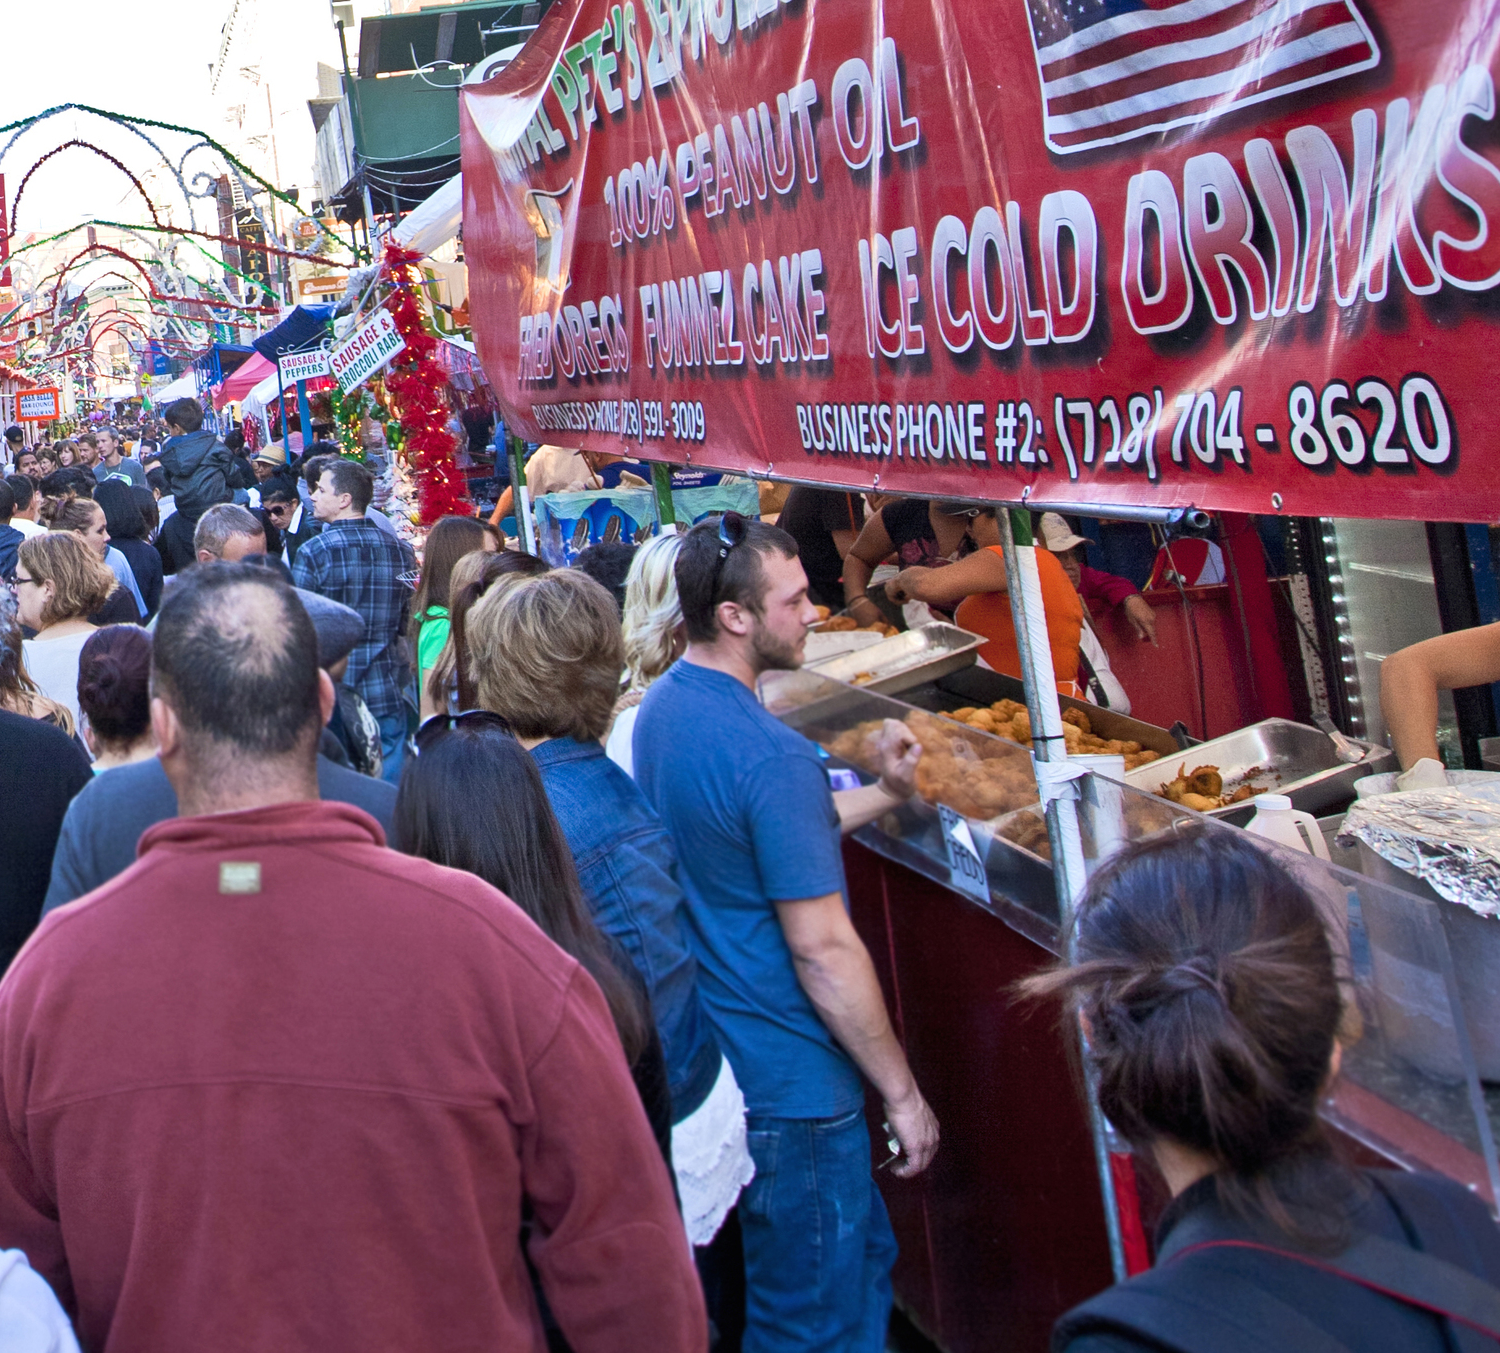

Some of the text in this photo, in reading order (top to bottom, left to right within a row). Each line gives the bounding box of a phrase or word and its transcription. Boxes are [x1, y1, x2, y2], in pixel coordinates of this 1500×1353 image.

[605, 149, 675, 249] 100%
[674, 79, 820, 219] PEANUT
[517, 312, 554, 381] FRIED
[553, 293, 631, 379] OREOS
[742, 248, 829, 364] CAKE
[858, 225, 924, 359] ICE
[931, 190, 1098, 353] COLD
[1121, 63, 1500, 335] DRINKS
[281, 353, 326, 369] SAUSAGE &
[285, 363, 324, 379] PEPPERS
[332, 317, 390, 374] SAUSAGE &
[338, 329, 402, 391] BROCCOLI RABE
[531, 401, 587, 431] BUSINESS
[618, 397, 643, 444] (78)
[643, 401, 665, 437] 591
[671, 401, 706, 441] 3009
[797, 402, 891, 458] BUSINESS
[896, 403, 985, 461] PHONE
[995, 403, 1049, 465] #2:
[1055, 389, 1163, 480] (718)
[1174, 390, 1244, 465] 704
[1288, 377, 1452, 467] 8620
[673, 472, 705, 480] Reynolds
